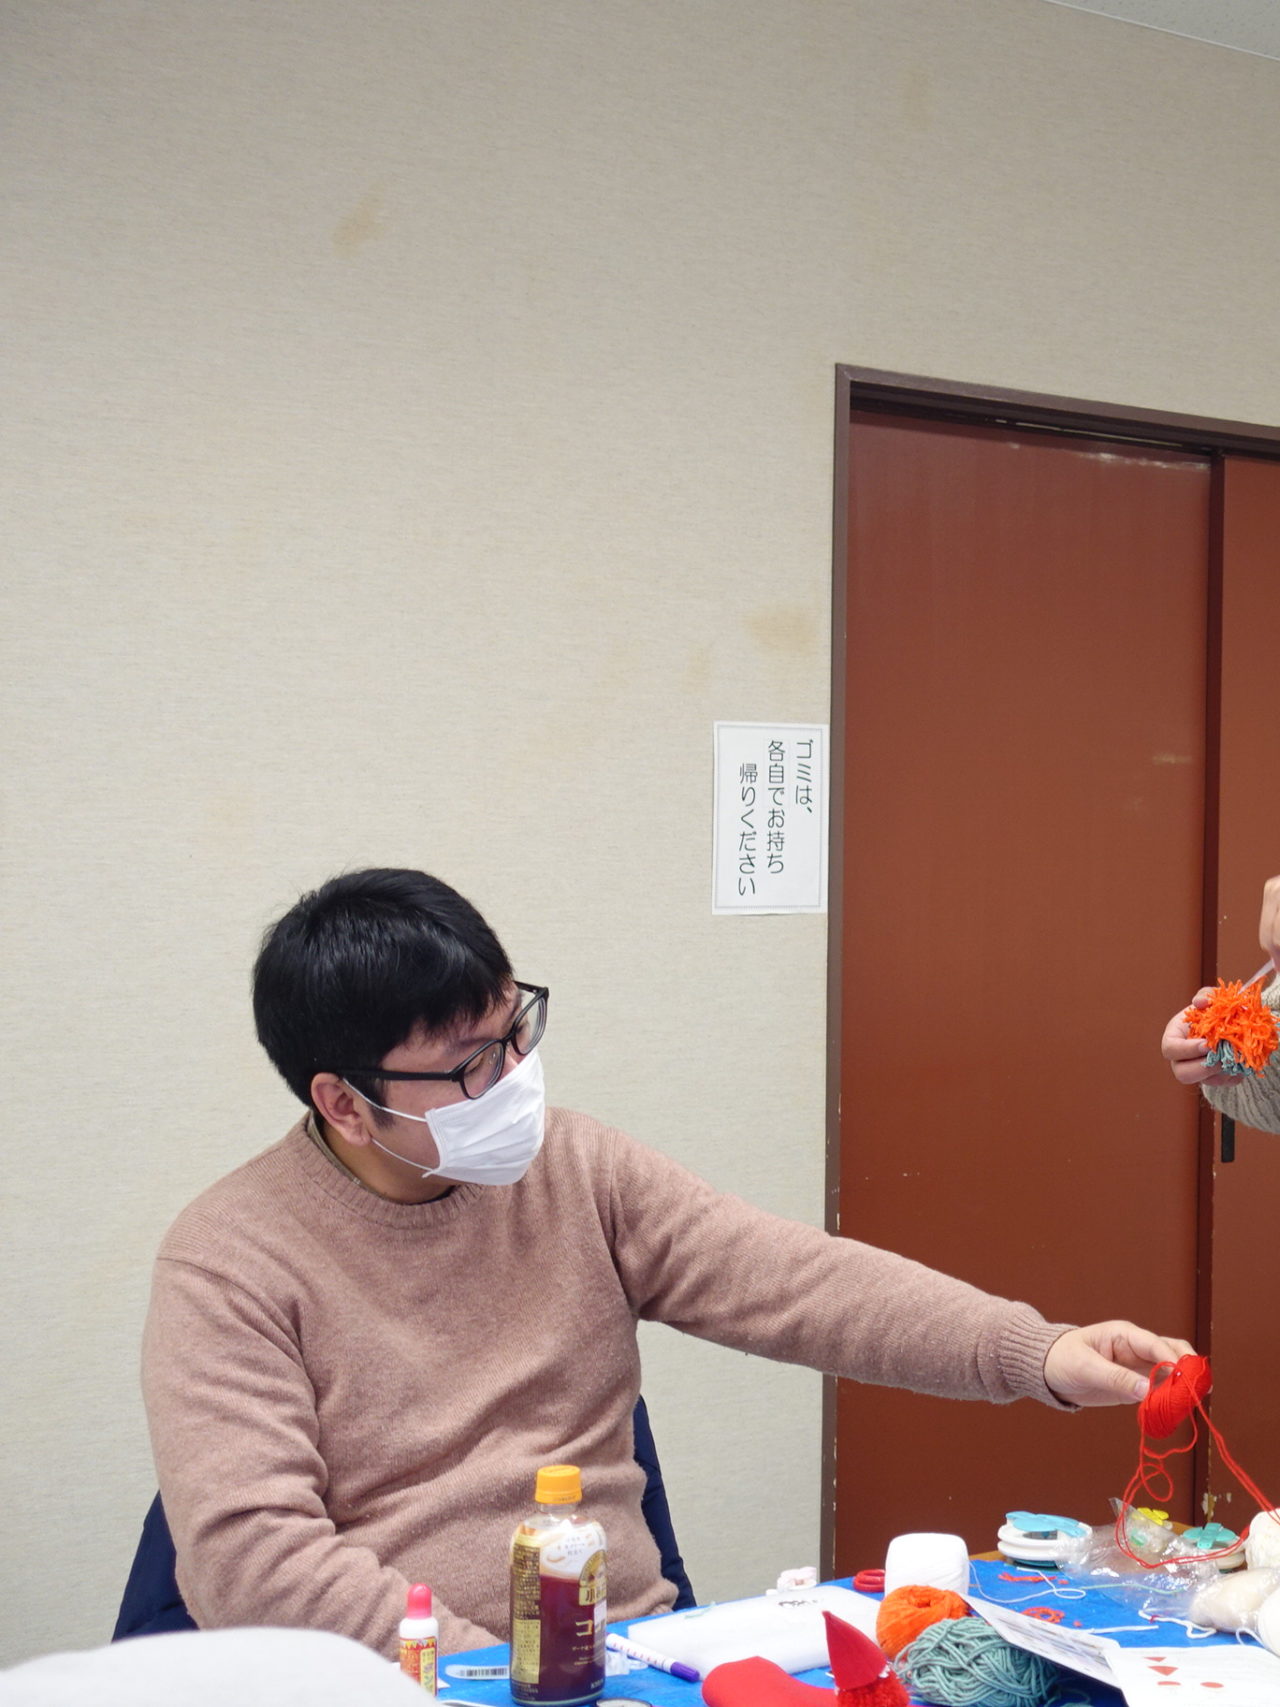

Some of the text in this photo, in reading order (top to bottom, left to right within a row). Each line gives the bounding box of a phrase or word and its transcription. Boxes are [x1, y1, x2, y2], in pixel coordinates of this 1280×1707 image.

[738, 762, 758, 896] 帰りください
[767, 740, 785, 874] 各自でお持ち
[795, 738, 814, 814] ゴミは、
